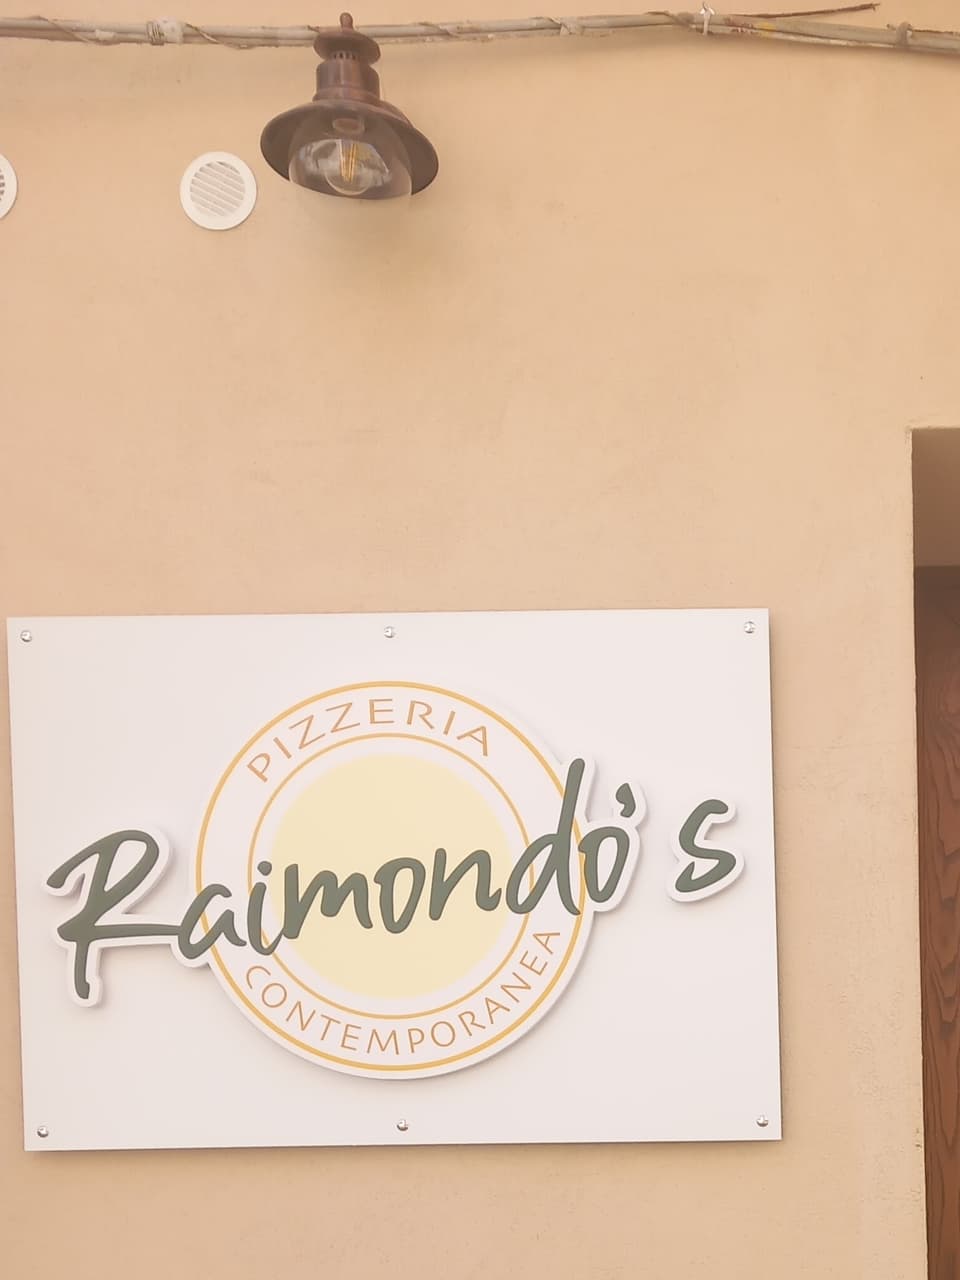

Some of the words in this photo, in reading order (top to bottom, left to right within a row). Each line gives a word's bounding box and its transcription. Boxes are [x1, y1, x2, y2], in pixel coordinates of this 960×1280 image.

[247, 697, 491, 783] PIZZERIA
[46, 757, 737, 1001] Raimondo's
[243, 927, 562, 1056] CONTEMPORANEA
